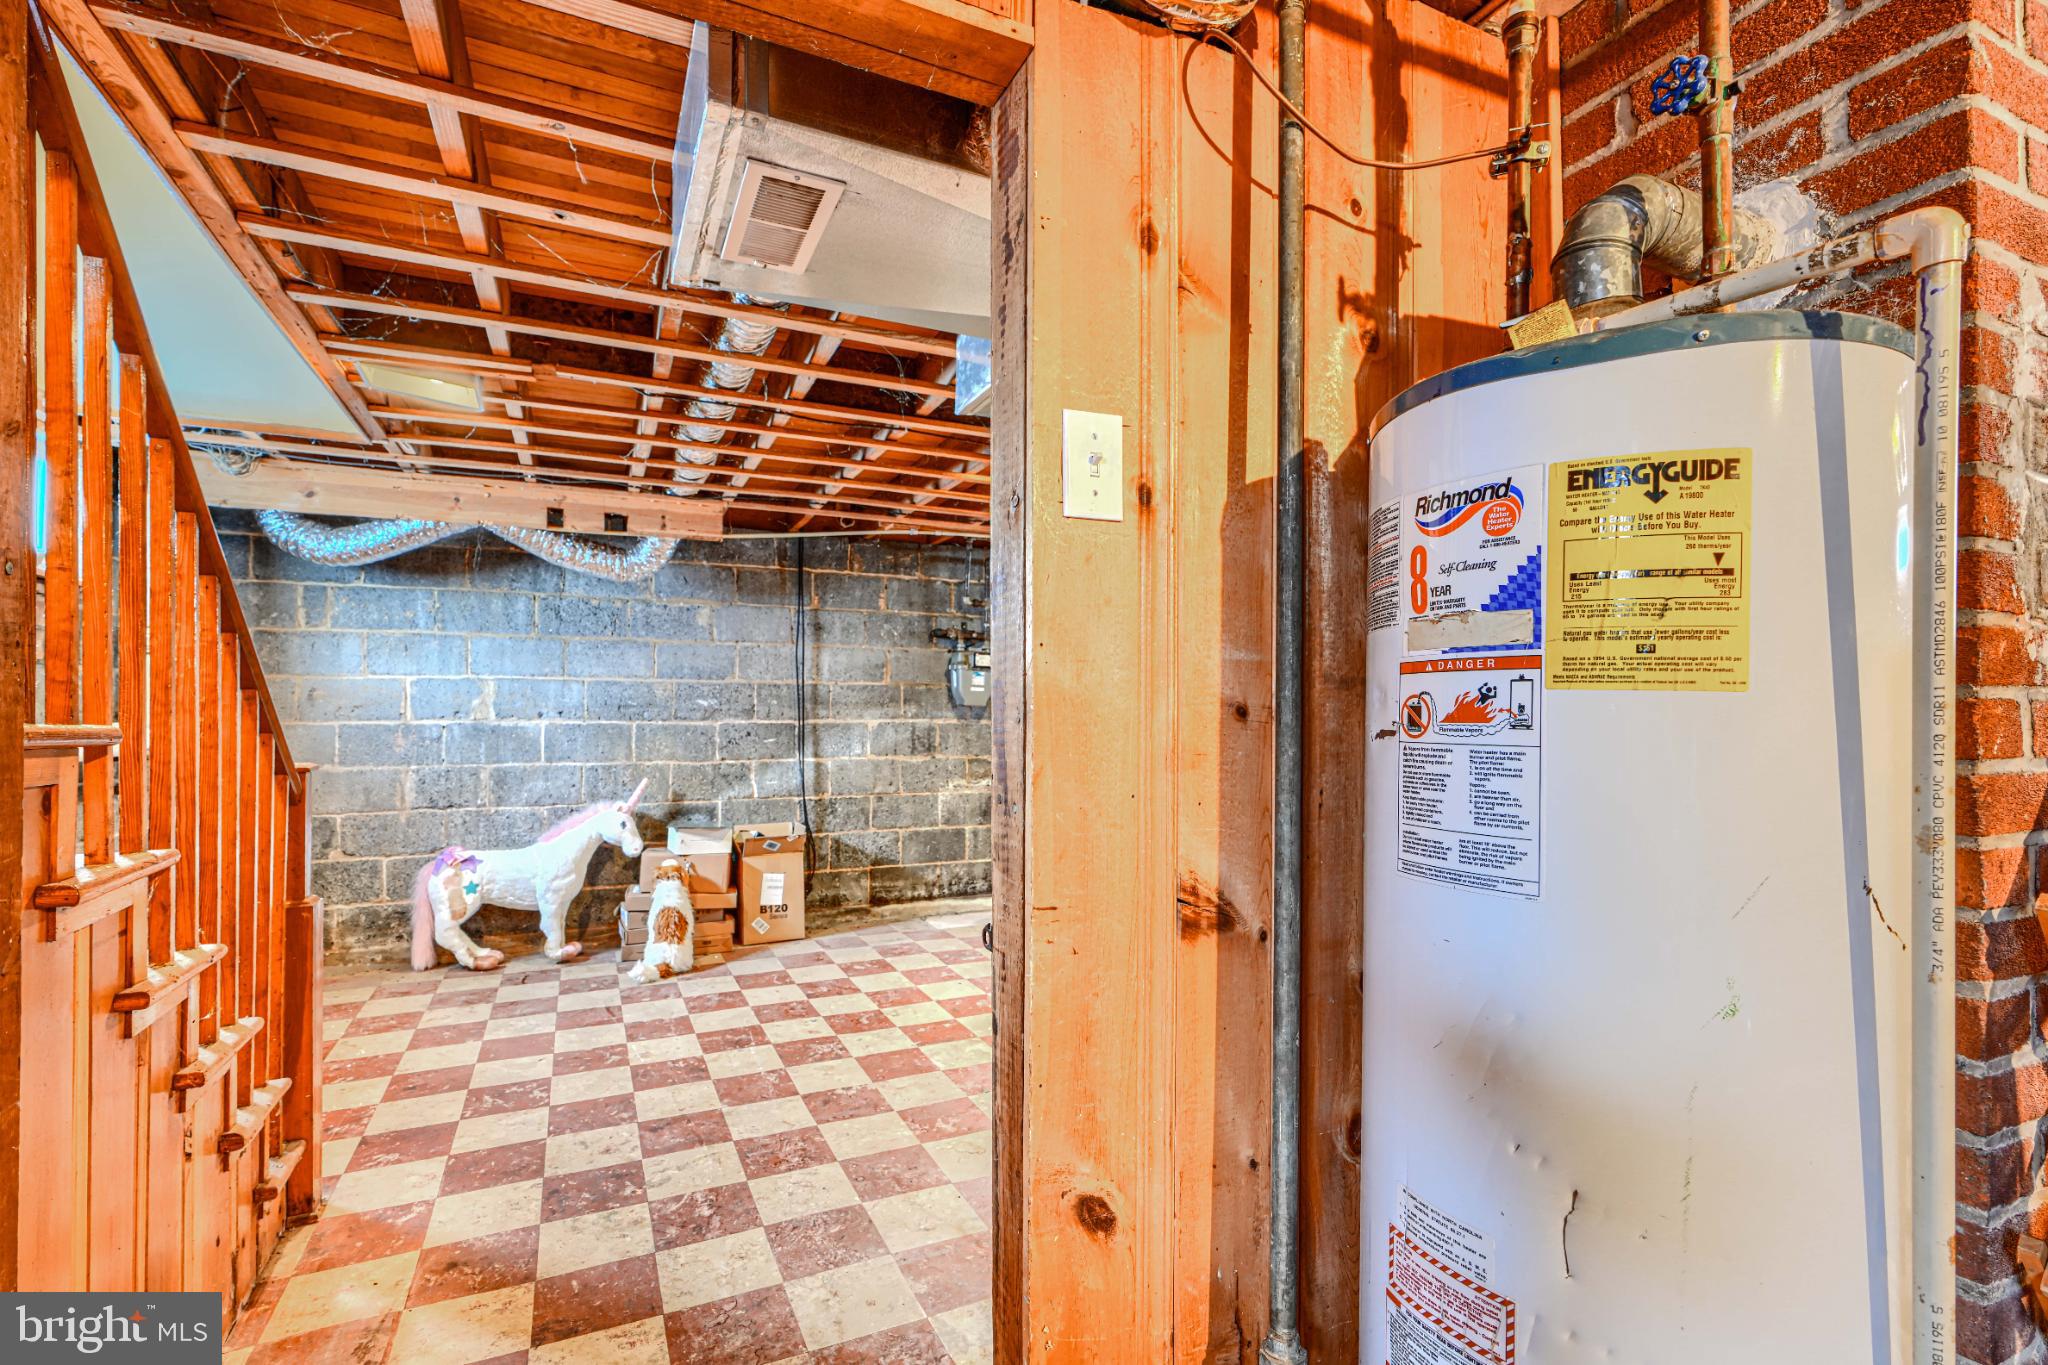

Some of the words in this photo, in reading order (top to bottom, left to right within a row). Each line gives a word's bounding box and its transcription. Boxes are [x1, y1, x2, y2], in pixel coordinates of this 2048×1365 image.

[1567, 458, 1740, 493] ENERGYGUIDE
[1415, 476, 1512, 517] Richmond
[1486, 522, 1514, 531] Experts
[1487, 516, 1512, 525] Heater
[1560, 518, 1591, 528] Compare
[1638, 513, 1653, 521] Use
[1656, 512, 1664, 520] of
[1666, 510, 1680, 519] this
[1683, 510, 1706, 518] Water
[1709, 510, 1735, 518] Heater
[1666, 521, 1681, 529] You
[1438, 558, 1498, 577] Self-Cleaning
[1410, 544, 1428, 615] 8
[1430, 585, 1452, 598] YEAR
[1934, 600, 1946, 676] ASTMD2846
[1438, 658, 1495, 670] DANGER
[1934, 686, 1945, 726] SDR11
[1932, 775, 1944, 809] CPVC
[760, 904, 788, 914] B120
[1932, 907, 1944, 932] ADA
